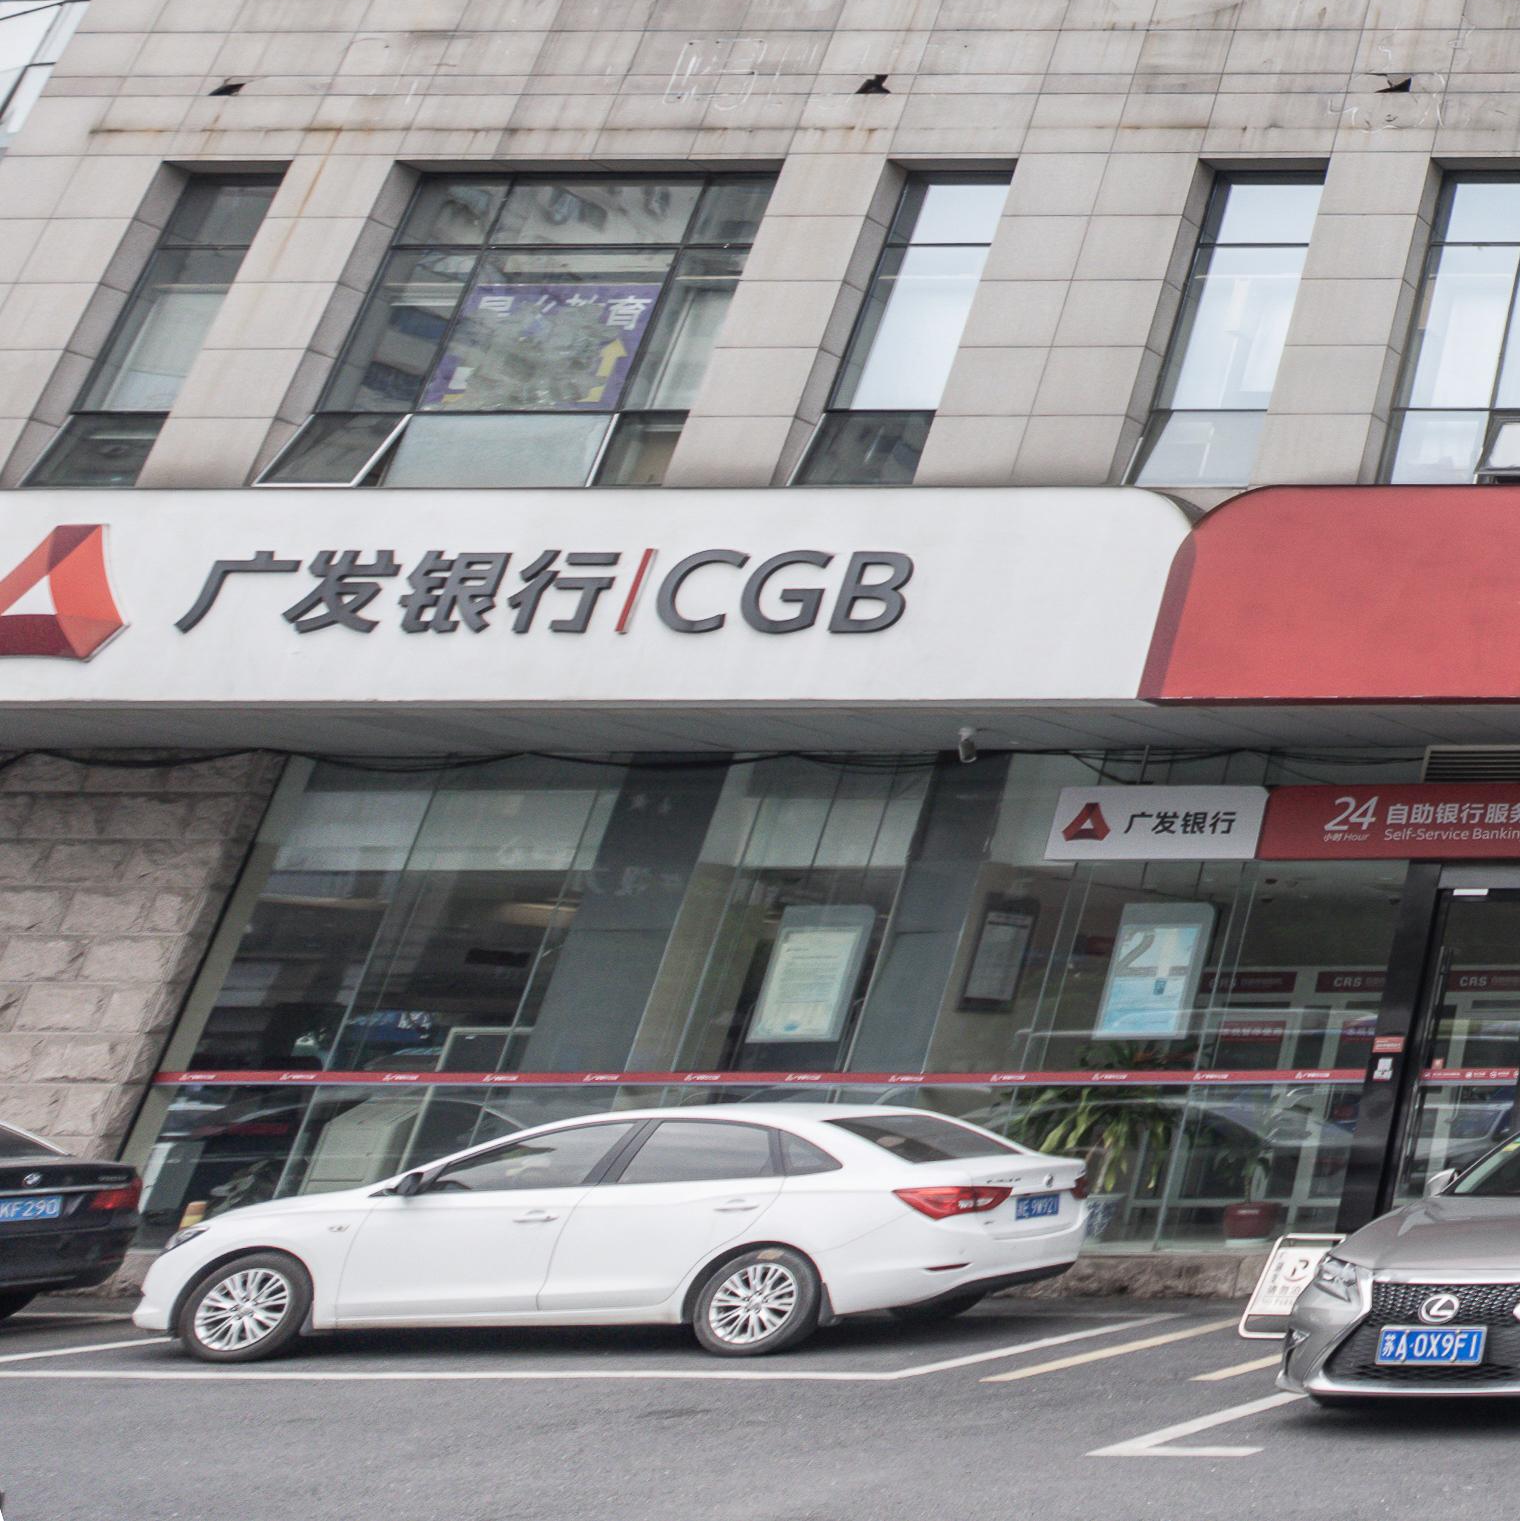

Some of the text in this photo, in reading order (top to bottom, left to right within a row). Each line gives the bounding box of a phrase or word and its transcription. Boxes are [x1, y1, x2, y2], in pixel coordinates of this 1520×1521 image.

[174, 548, 914, 636] 广发银行 CGB
[1323, 795, 1380, 832] 24
[1124, 809, 1237, 836] 广发银行
[1343, 832, 1370, 842] Hour
[1384, 827, 1469, 842] Self-Service
[1333, 976, 1362, 988] CRS
[1459, 976, 1488, 987] CRS
